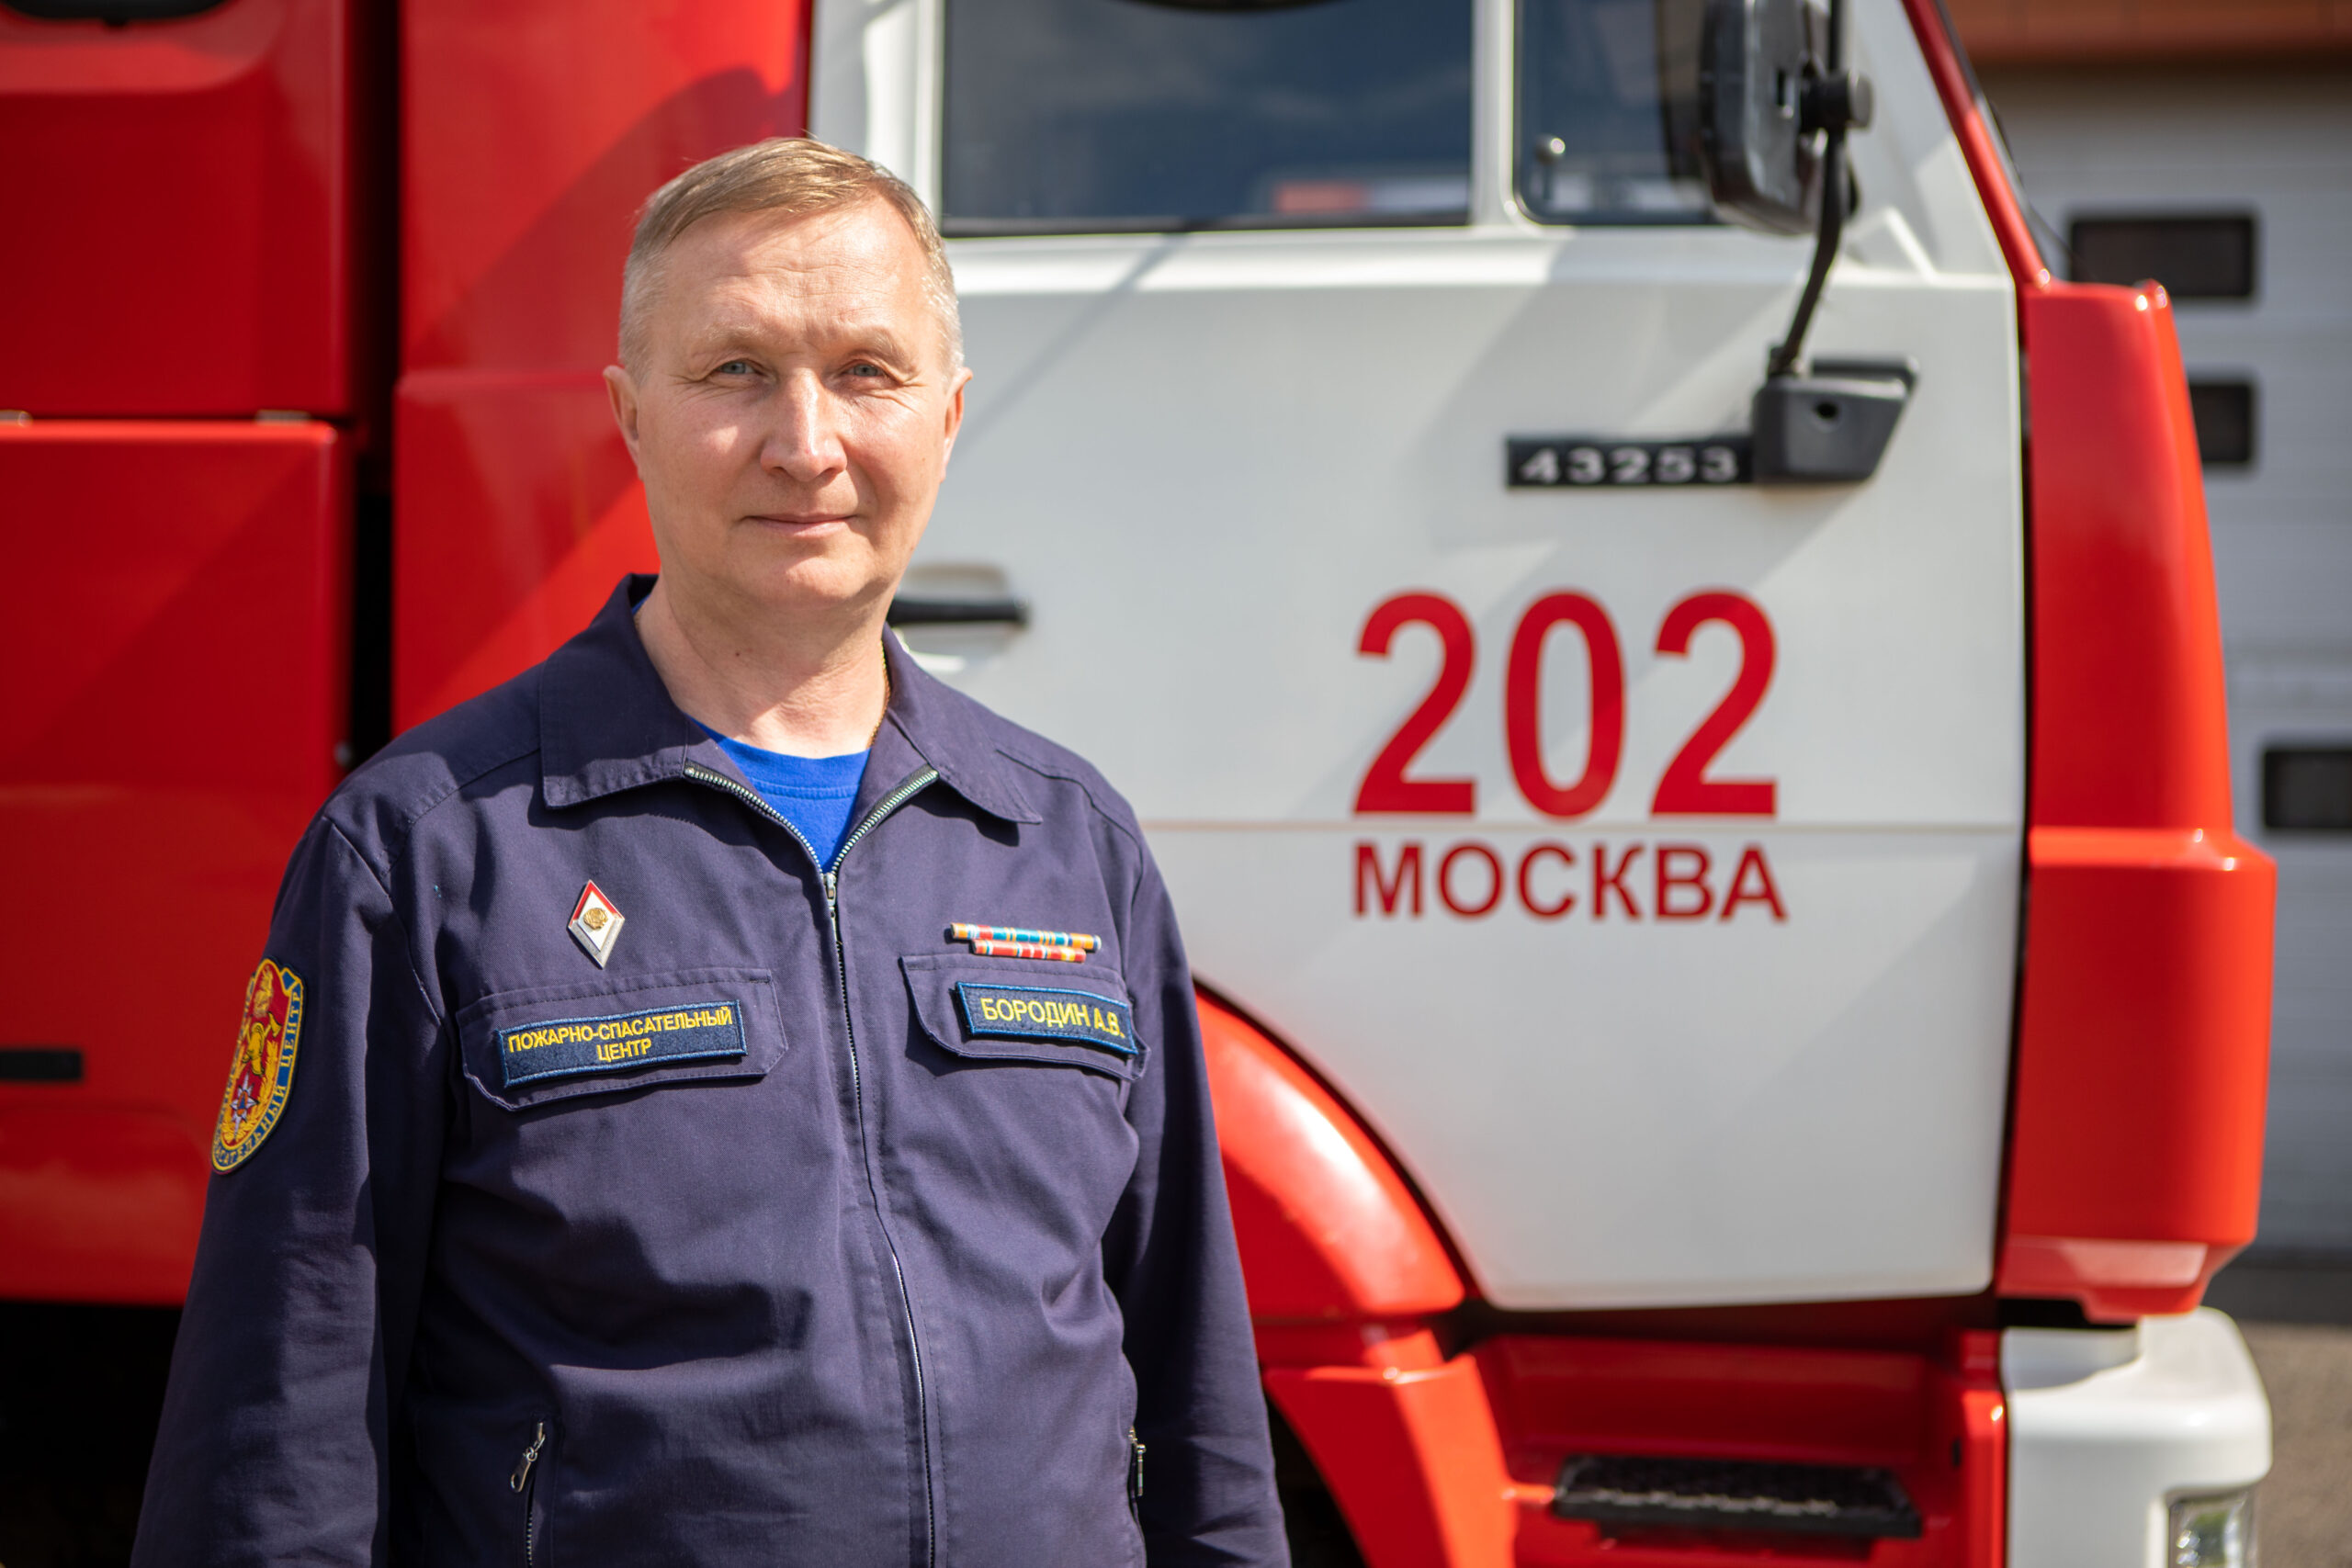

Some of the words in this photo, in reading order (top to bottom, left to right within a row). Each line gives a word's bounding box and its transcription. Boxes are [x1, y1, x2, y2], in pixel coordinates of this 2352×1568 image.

[1520, 446, 1738, 484] 43253
[1353, 588, 1778, 819] 202
[1353, 840, 1788, 922] МОСКВА
[279, 991, 301, 1067] ЦЕНТР
[507, 1006, 733, 1054] ПОЖАРНО-СПАСАТЕЛЬНЫЙ
[979, 997, 1091, 1029] БОРОДИН
[1093, 1008, 1125, 1039] А.В.
[596, 1038, 652, 1063] ЦЕНТР
